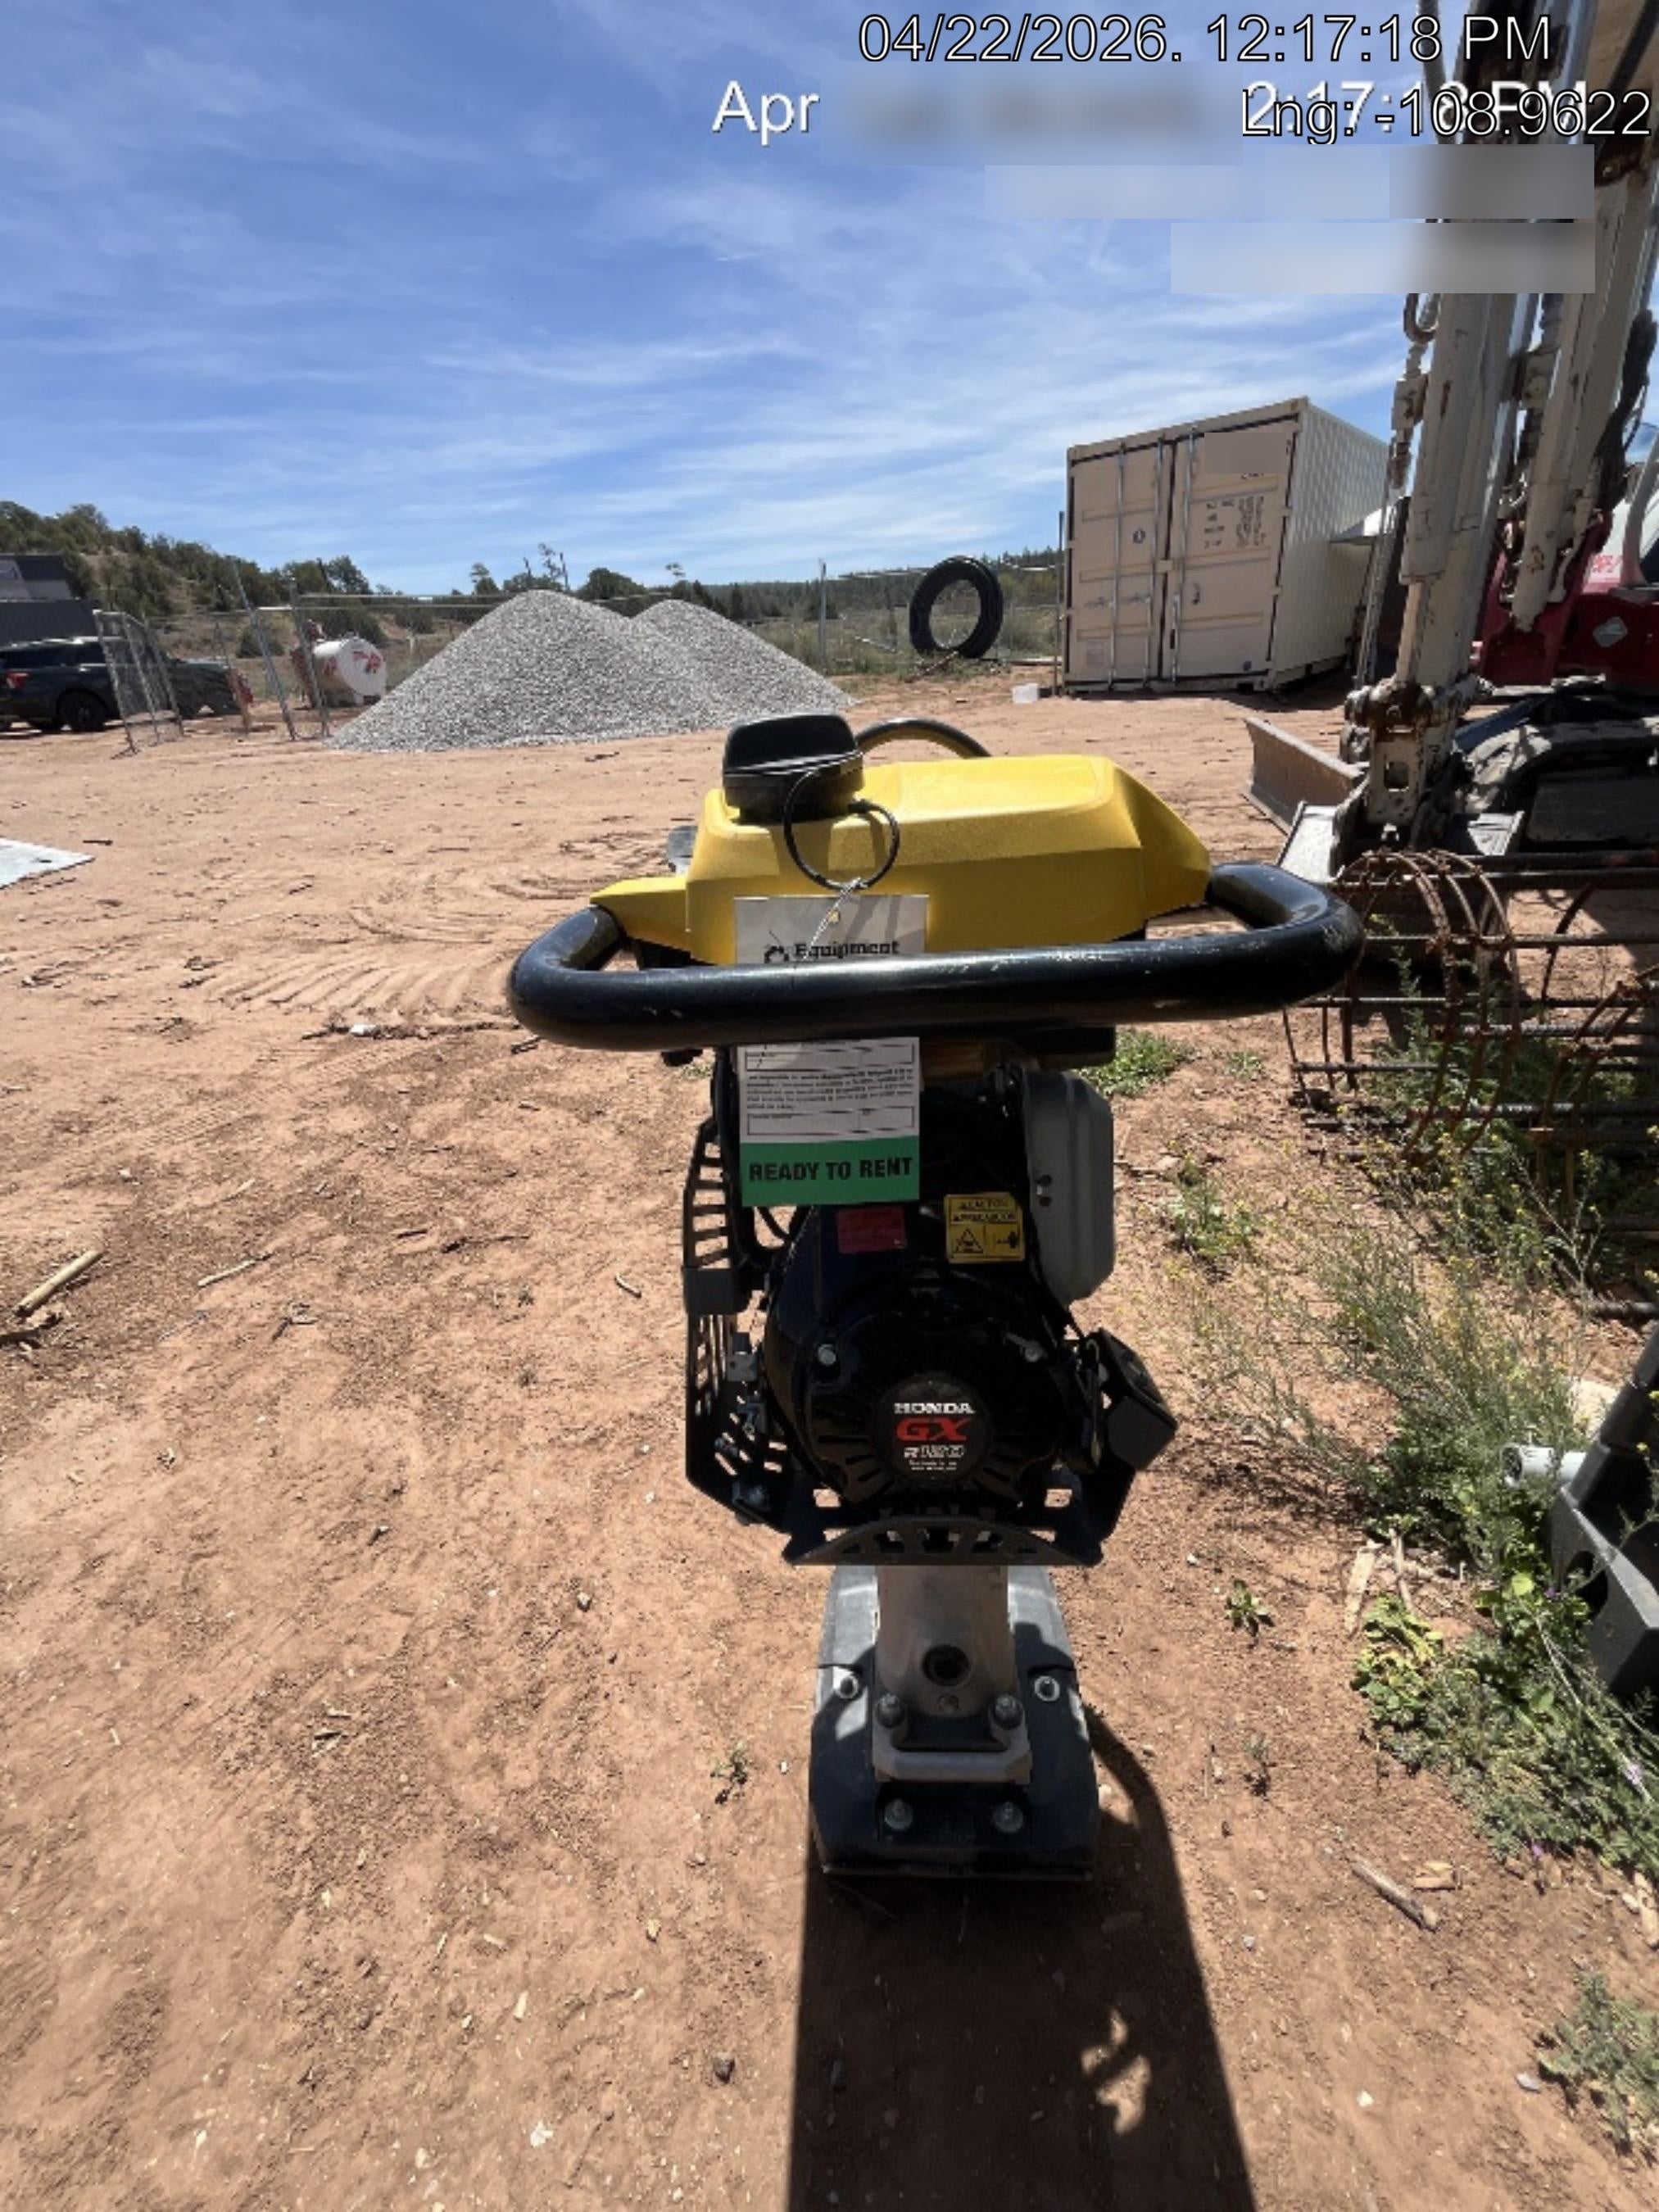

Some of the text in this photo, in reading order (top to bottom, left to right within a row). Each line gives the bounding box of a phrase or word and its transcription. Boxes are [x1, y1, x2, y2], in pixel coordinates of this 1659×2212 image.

[795, 941, 900, 959] Equipment
[749, 1157, 913, 1182] READY TO RENT
[894, 1402, 975, 1414] HONDA
[895, 1416, 972, 1442] GX
